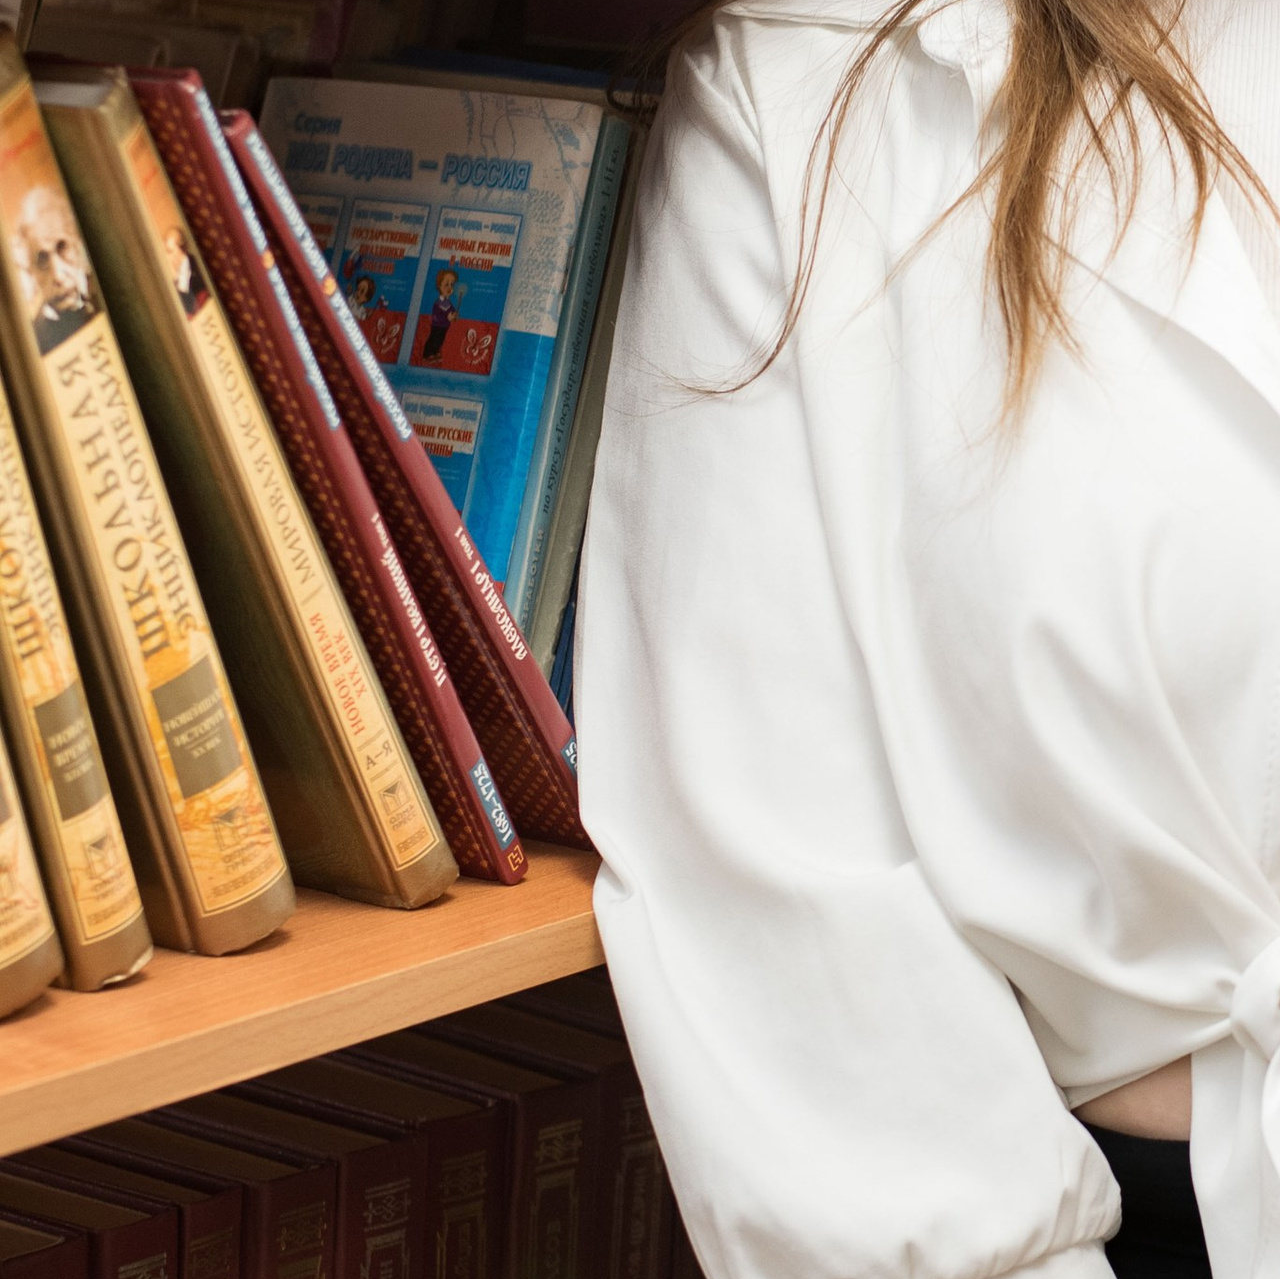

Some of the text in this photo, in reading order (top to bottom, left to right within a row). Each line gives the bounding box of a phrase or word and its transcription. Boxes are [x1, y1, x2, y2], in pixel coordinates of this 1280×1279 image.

[331, 144, 413, 181] РОДИНА
[441, 153, 534, 192] РОССИЯ
[439, 237, 512, 257] МИРОВЫЕ РЕЛИГИИ
[459, 257, 494, 272] РОССИИ
[199, 313, 315, 585] МИРОВАЯ ИСТОРИЯ
[437, 426, 474, 443] РУССКИЕ
[521, 528, 545, 634] АЗРАБОТКИ
[542, 496, 551, 515] по
[547, 447, 562, 491] курсу
[556, 299, 589, 443] «Государственная
[57, 355, 170, 661] ШКОЛЬНАЯ
[88, 333, 200, 642] ЭНЦИКЛОПЕДИЯ
[379, 546, 420, 629] ВЕЛИКИЙ
[474, 572, 527, 661] АЛЕКСАНДР
[307, 612, 366, 736] НОВОЕ ВРЕМЯ
[331, 628, 369, 698] XIX ВЕК
[417, 633, 446, 687] ПЕТР
